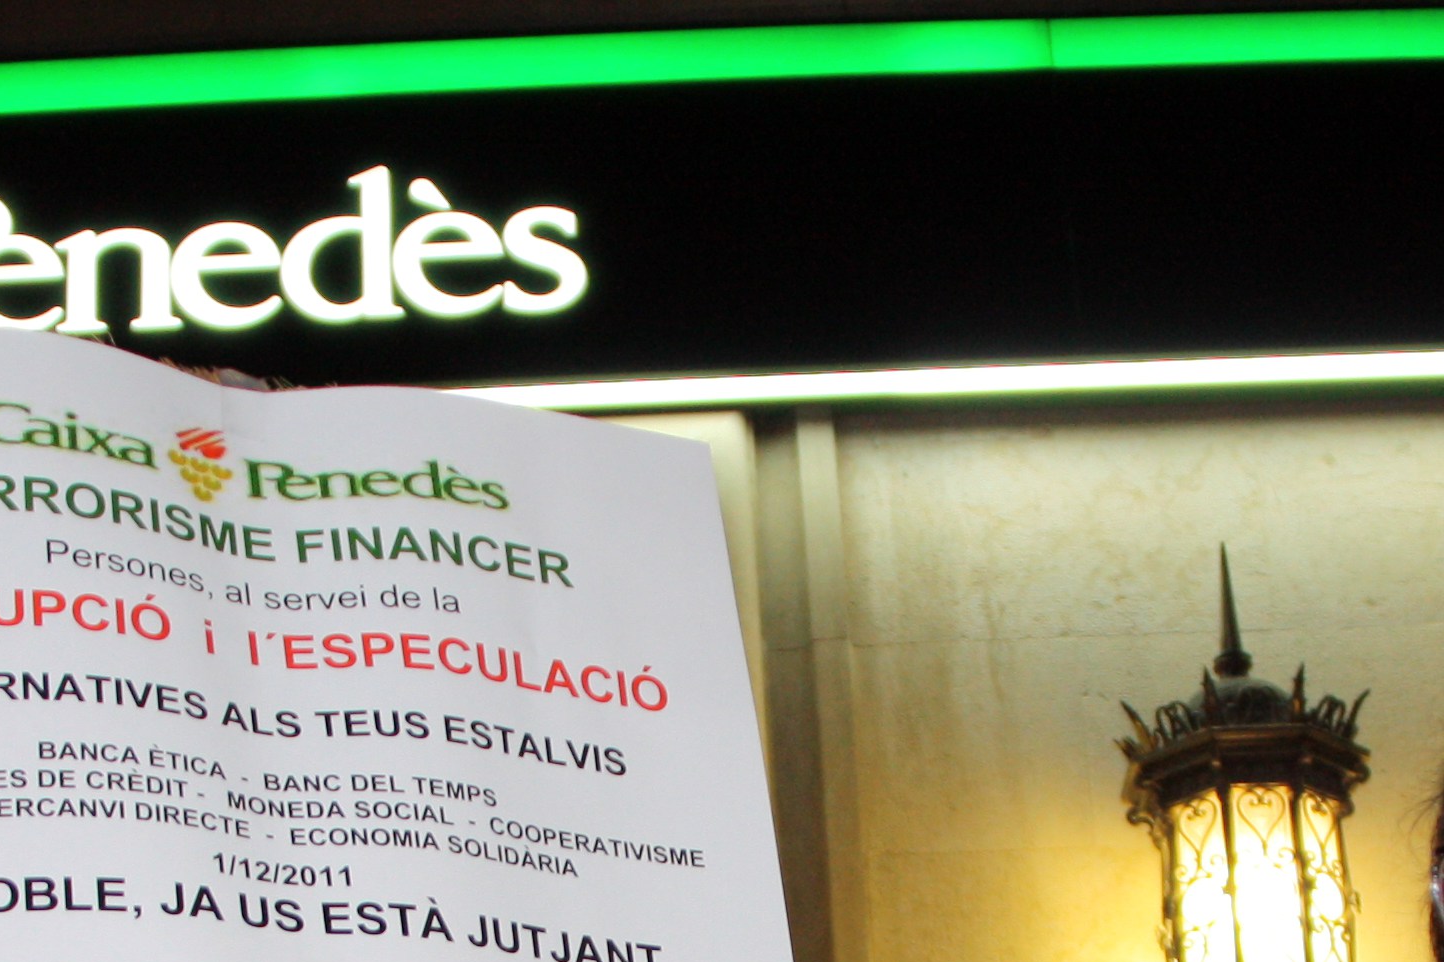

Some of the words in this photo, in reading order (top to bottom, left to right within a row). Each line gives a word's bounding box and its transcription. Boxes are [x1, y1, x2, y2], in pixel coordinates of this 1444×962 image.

[244, 459, 510, 511] Penedès
[46, 539, 212, 601] Persones,
[226, 582, 251, 606] al
[264, 585, 366, 611] servei
[380, 584, 421, 609] de
[433, 587, 460, 613] la
[295, 526, 573, 588] FINANCER
[204, 619, 215, 654] i
[221, 701, 301, 738] ALS
[314, 709, 430, 739] TEUS
[444, 715, 626, 776] ESTALVIS
[38, 741, 140, 764] BANCA
[149, 744, 226, 780] ÈTICA
[263, 773, 341, 792] BANC
[351, 774, 405, 793] DEL
[412, 777, 497, 807] TEMPS
[38, 769, 76, 789] DE
[86, 768, 188, 798] CRÈDIT
[227, 790, 346, 819] MONEDA
[354, 800, 454, 826] SOCIAL
[488, 817, 705, 868] COOPERATIVISME
[135, 801, 250, 839] DIRECTE
[290, 827, 440, 851] ECONOMIA
[448, 832, 578, 877] SOLIDÀRIA
[213, 852, 351, 887] 1/12/2011
[160, 881, 225, 922] JA
[238, 892, 304, 933] US
[321, 897, 454, 942] ESTÀ
